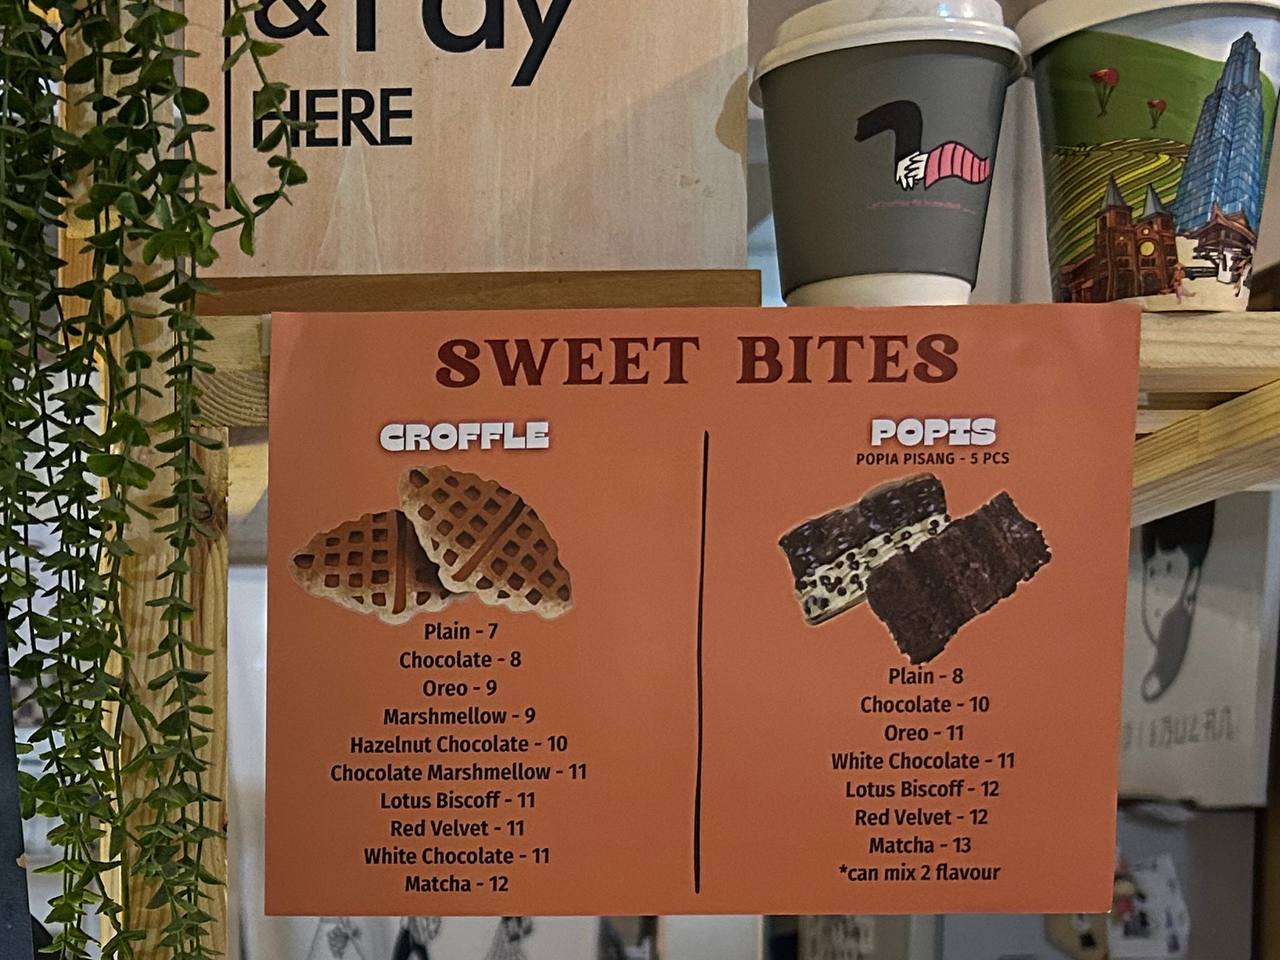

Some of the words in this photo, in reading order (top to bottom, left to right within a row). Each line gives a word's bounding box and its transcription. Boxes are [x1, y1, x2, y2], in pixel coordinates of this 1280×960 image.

[253, 88, 412, 148] HERE
[435, 336, 701, 388] SWEET
[736, 333, 959, 384] BITES
[380, 421, 550, 452] CROFFLE
[871, 418, 996, 447] POPIS
[856, 452, 899, 465] POPIA
[903, 452, 955, 465] PISANG
[970, 452, 978, 465] 5
[983, 451, 1010, 465] PCS
[424, 621, 471, 641] Plain
[488, 622, 498, 640] 7
[399, 650, 493, 669] Chocolate
[510, 650, 522, 668] 8
[889, 665, 934, 685] Plain
[952, 667, 964, 685] 8
[422, 679, 469, 697] Oreo
[485, 679, 498, 696] 9
[860, 695, 952, 714] Chocolate
[969, 695, 990, 713] 10
[383, 706, 507, 726] Marshmellow
[524, 707, 536, 725] 9
[884, 724, 929, 742] Oreo
[946, 724, 964, 741] 11
[350, 734, 432, 754] Hazelnut
[436, 734, 529, 753] Chocolate
[547, 735, 568, 752] 10
[831, 751, 884, 770] White
[888, 751, 980, 770] Chocolate
[997, 752, 1015, 769] 11
[330, 763, 423, 782] Chocolate
[427, 762, 551, 781] Marshmellow
[568, 763, 587, 780] 11
[846, 781, 896, 798] Lotus
[901, 778, 965, 798] Biscoff
[980, 780, 1000, 797] 12
[380, 792, 432, 810] Lotus
[436, 789, 502, 809] Biscoff
[517, 791, 535, 809] 11
[855, 807, 890, 826] Red
[894, 807, 952, 826] Velvet
[969, 808, 988, 825] 12
[390, 818, 426, 837] Red
[430, 818, 489, 837] Velvet
[506, 820, 524, 836] 11
[869, 835, 935, 854] Matcha
[952, 836, 972, 854] 13
[363, 845, 417, 865] White
[421, 846, 514, 865] Chocolate
[532, 847, 550, 864] 11
[884, 862, 917, 881] mix
[920, 864, 931, 881] 2
[935, 862, 1001, 881] flavour
[404, 874, 472, 893] Matcha
[489, 875, 509, 892] 12
